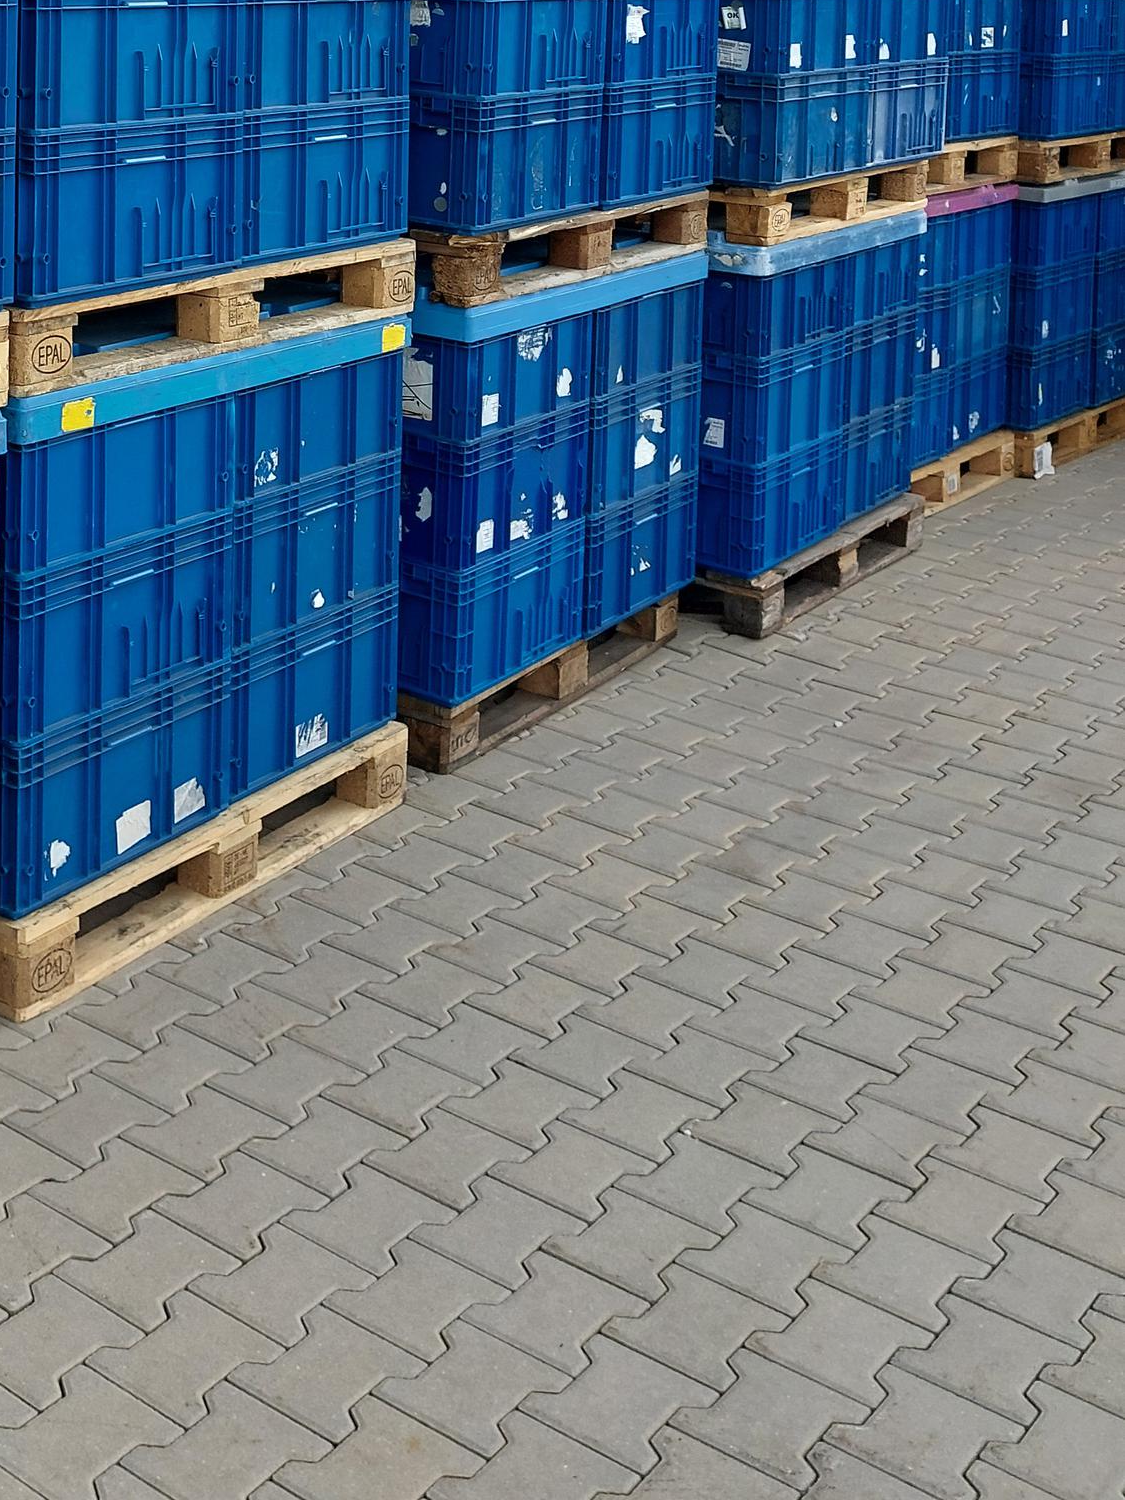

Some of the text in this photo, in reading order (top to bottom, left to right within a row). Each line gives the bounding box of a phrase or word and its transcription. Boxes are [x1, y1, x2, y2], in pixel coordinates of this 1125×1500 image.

[392, 276, 412, 296] EPAL
[38, 342, 67, 367] EPAL
[380, 769, 400, 794] EPAL
[37, 954, 66, 988] EPAL
